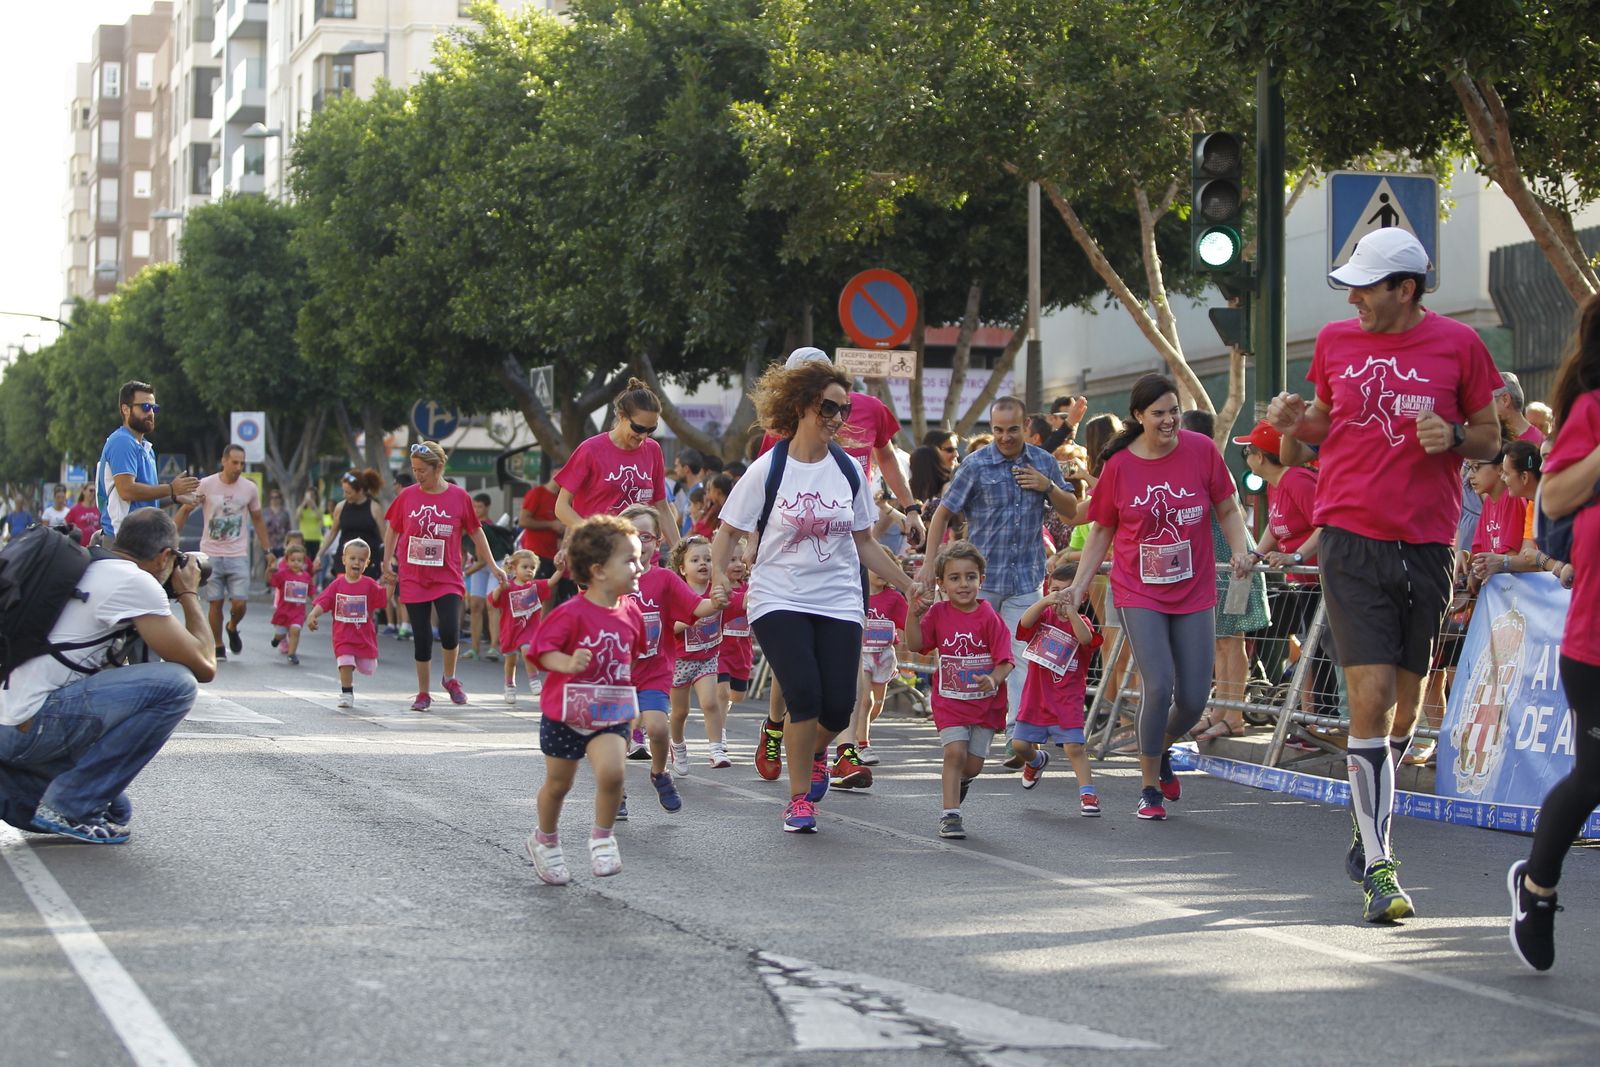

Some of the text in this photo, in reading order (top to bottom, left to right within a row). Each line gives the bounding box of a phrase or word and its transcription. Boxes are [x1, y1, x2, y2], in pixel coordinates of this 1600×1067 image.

[867, 352, 888, 360] MOTOS
[1391, 394, 1401, 416] 4
[1402, 395, 1434, 404] CARRERA
[424, 547, 437, 556] 85
[1170, 555, 1180, 567] 4
[1515, 705, 1554, 753] DE
